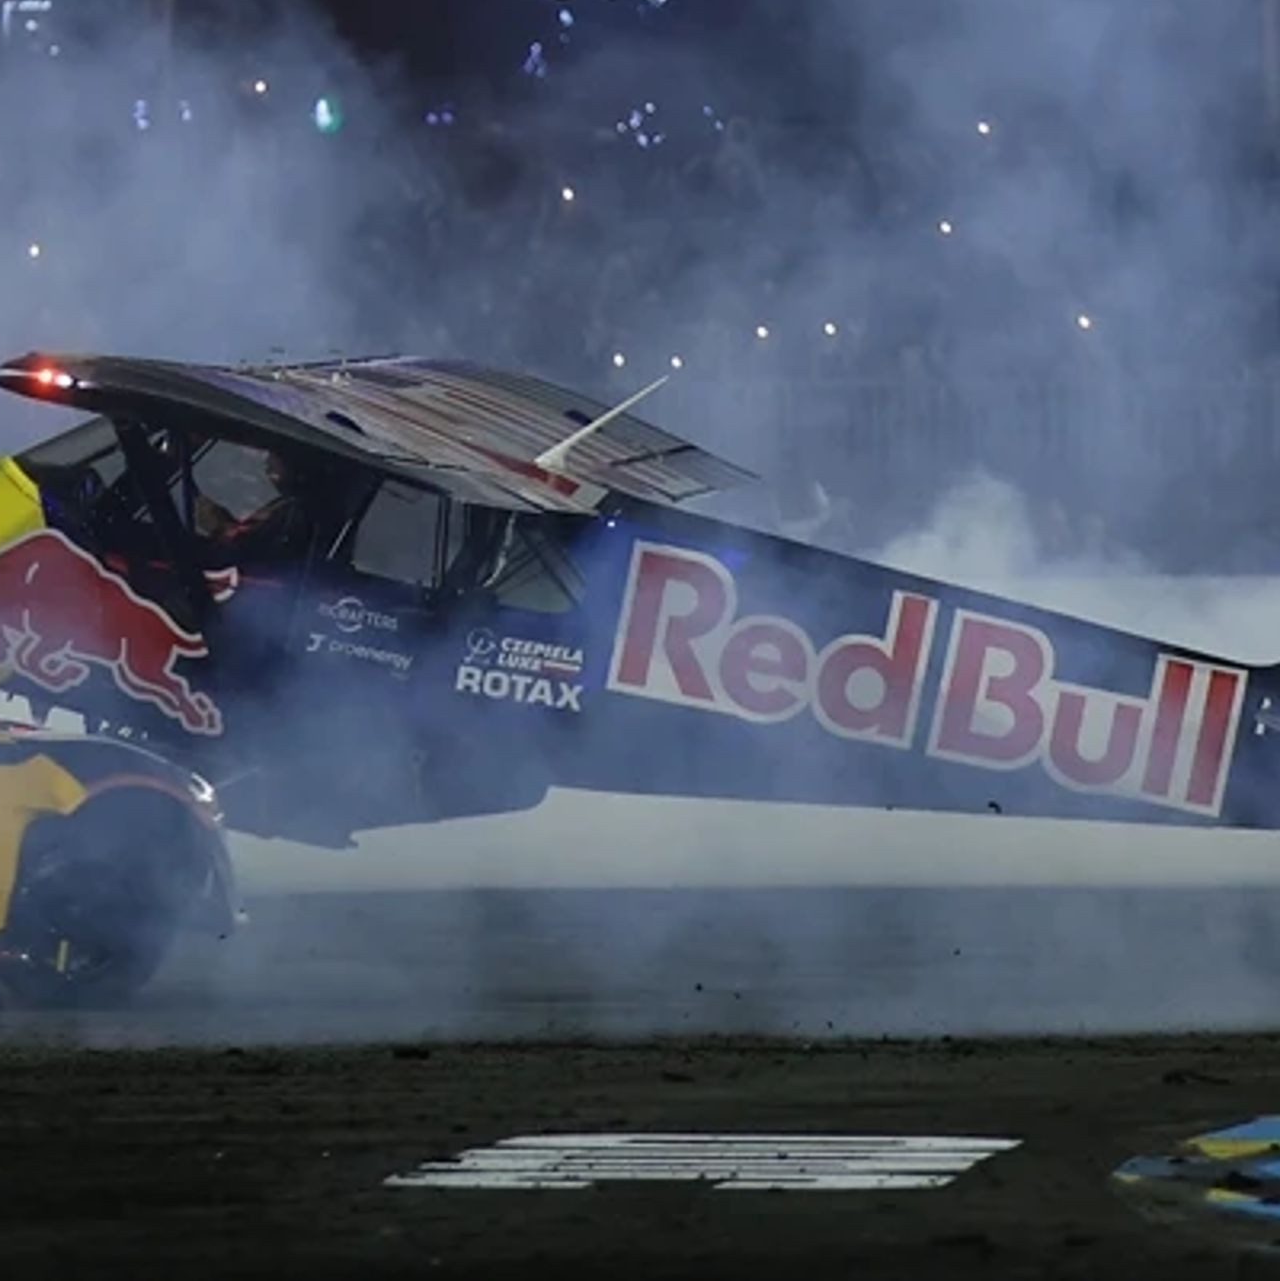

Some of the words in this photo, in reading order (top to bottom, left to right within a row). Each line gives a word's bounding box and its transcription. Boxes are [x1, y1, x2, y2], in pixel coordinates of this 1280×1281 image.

[455, 664, 584, 712] ROTAX
[606, 539, 940, 751] Red
[926, 607, 1249, 818] Bull
